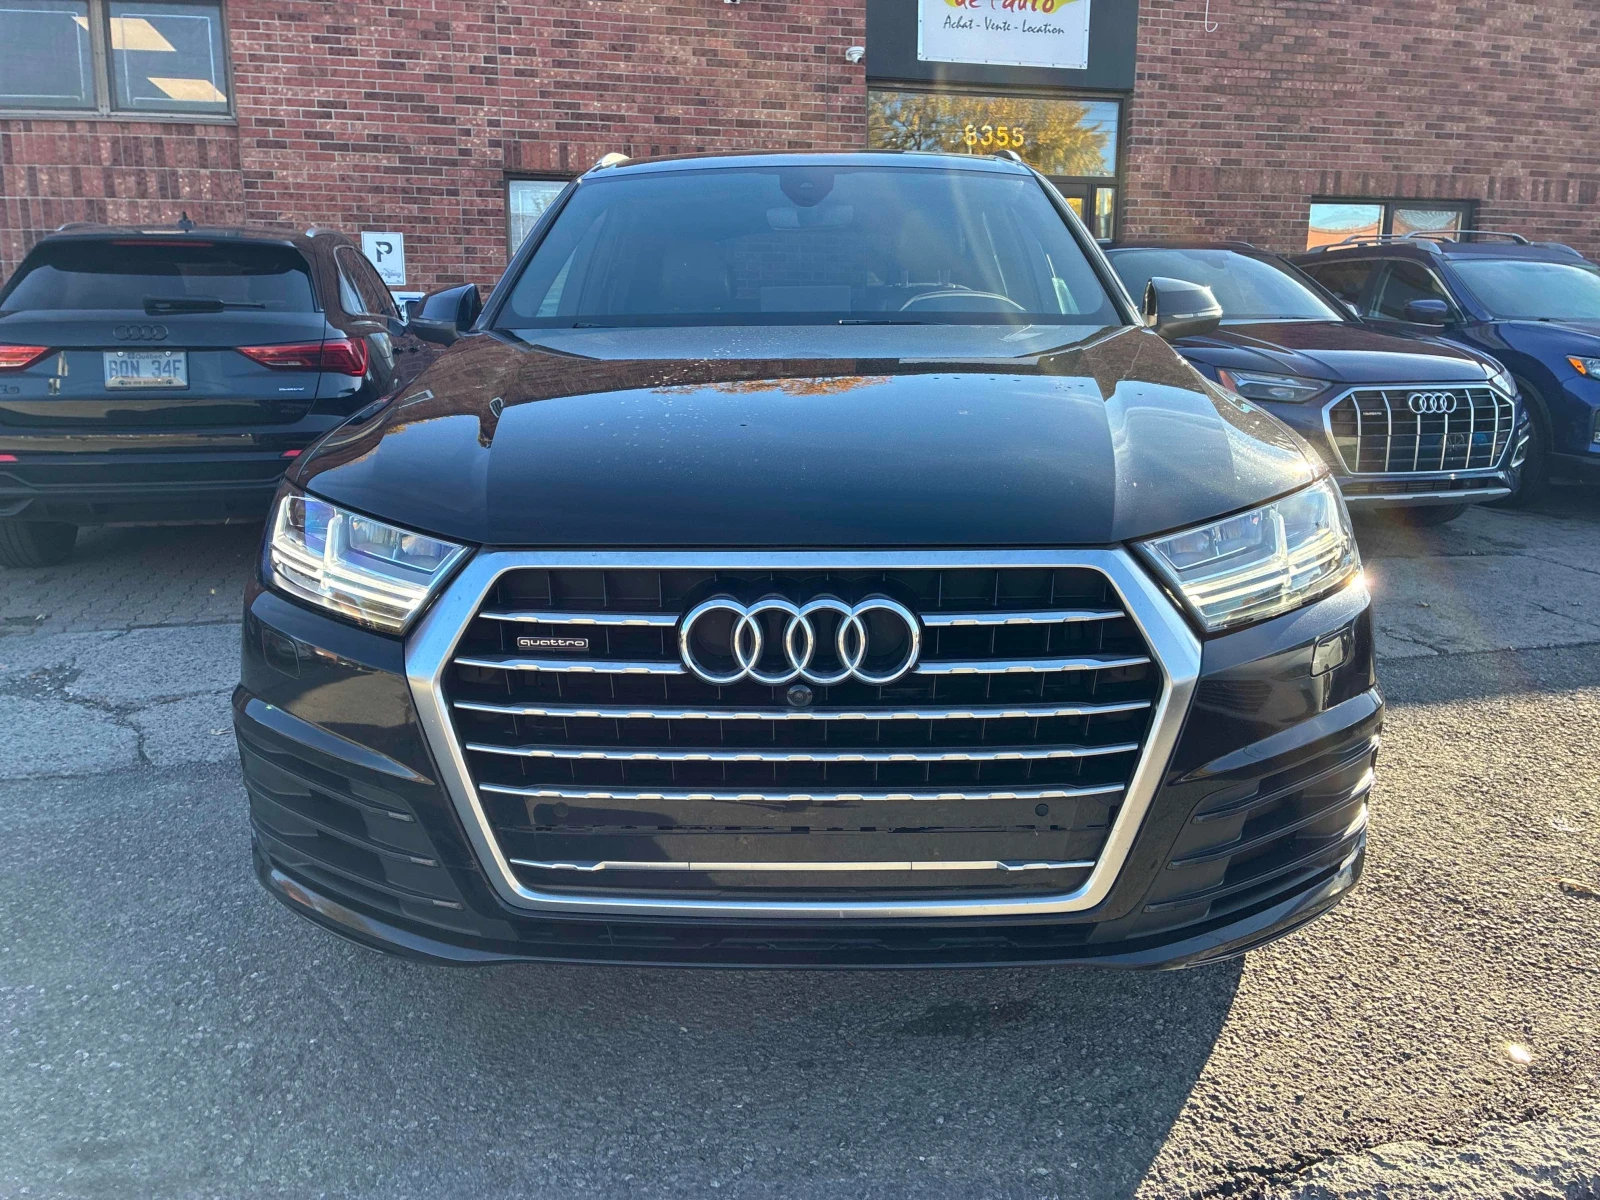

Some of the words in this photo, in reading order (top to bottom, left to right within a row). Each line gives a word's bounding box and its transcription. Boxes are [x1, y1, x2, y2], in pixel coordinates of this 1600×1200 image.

[991, 0, 1055, 13] auo
[943, 15, 974, 29] Achat
[984, 16, 1011, 31] Vente
[1022, 20, 1065, 35] Location
[963, 124, 1025, 147] 8355
[375, 241, 393, 263] P
[151, 359, 182, 378] 34F
[520, 639, 585, 647] quattro
